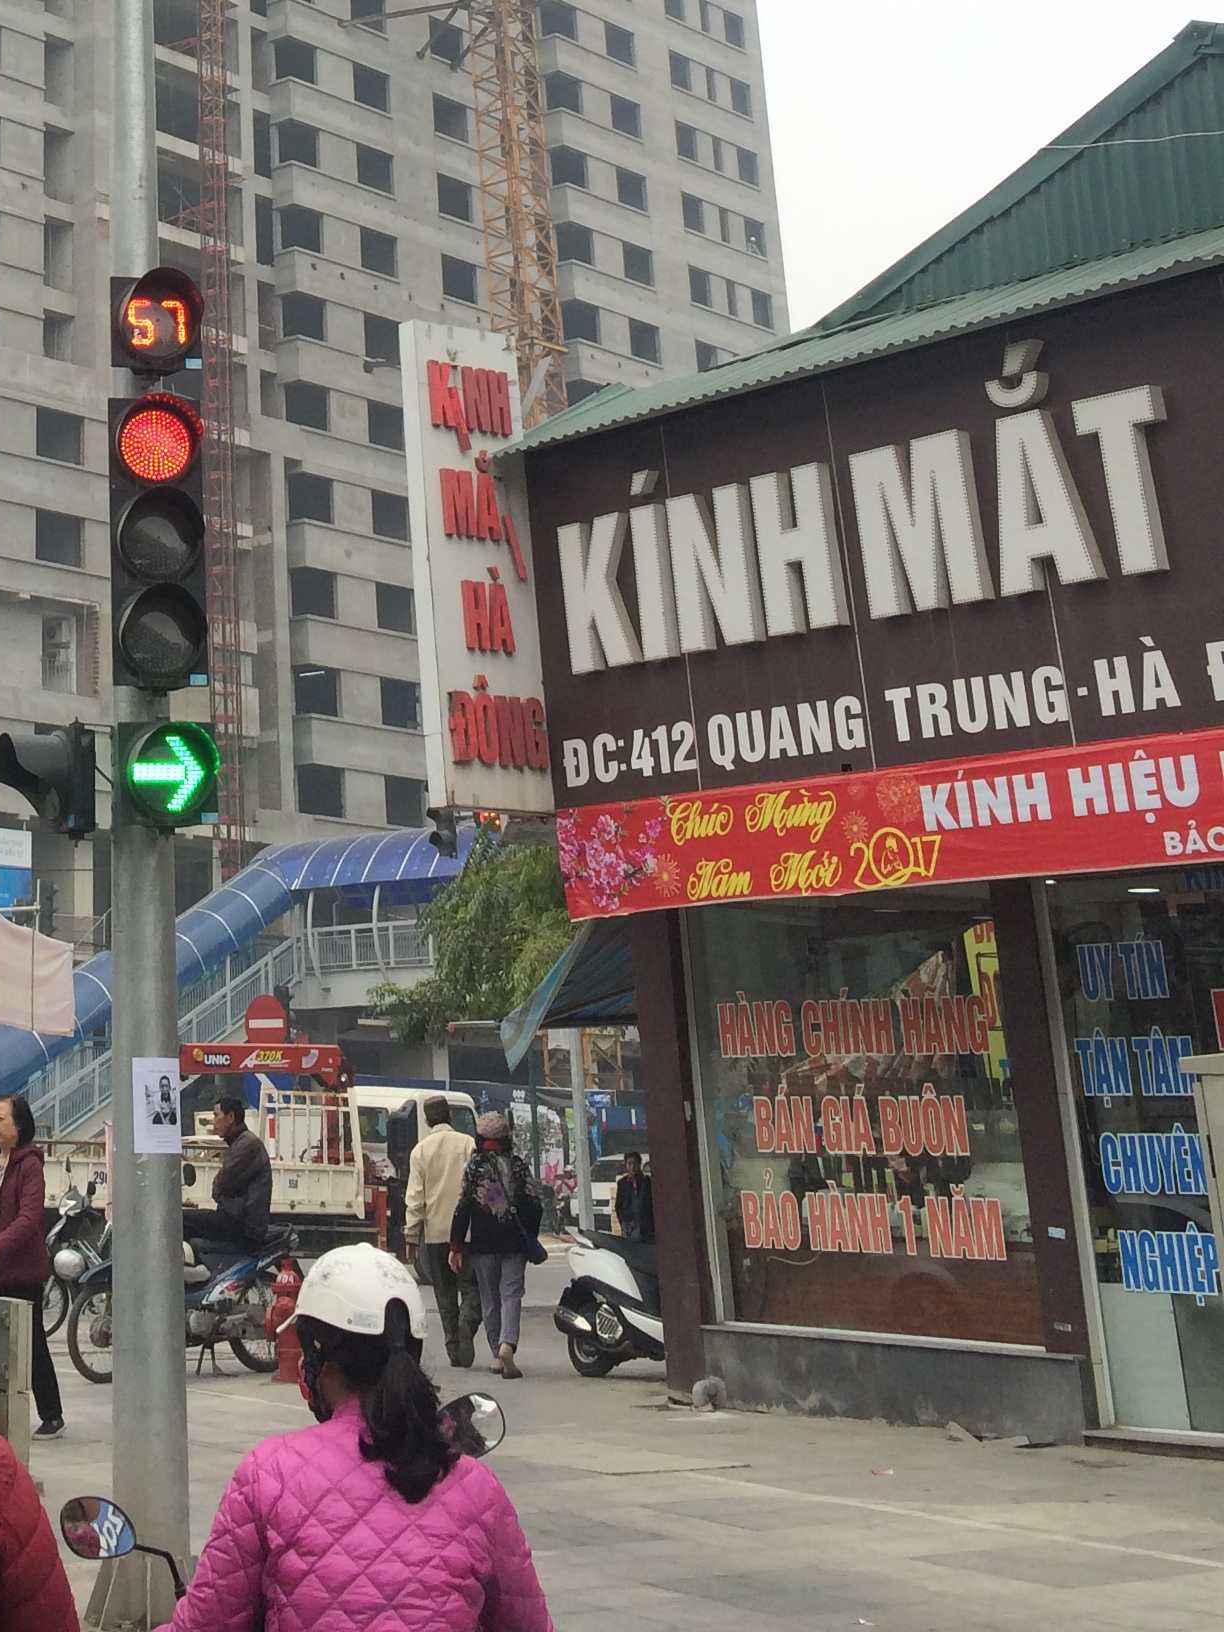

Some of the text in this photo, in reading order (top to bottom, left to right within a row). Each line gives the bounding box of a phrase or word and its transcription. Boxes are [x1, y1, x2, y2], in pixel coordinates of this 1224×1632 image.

[127, 299, 186, 346] 57
[556, 339, 1171, 675] KÍNH MẮT
[460, 566, 516, 655] HÀ
[448, 673, 548, 770] ĐÔNG
[707, 695, 866, 768] QUANG
[667, 789, 837, 846] Chúc Mừng
[919, 770, 1052, 833] KÍNH
[1067, 749, 1200, 825] HIỆU
[770, 849, 842, 896] Mới
[1076, 943, 1114, 1002] UY
[1117, 932, 1170, 1000] TÍN
[717, 991, 796, 1058] HÀNG
[801, 986, 896, 1057] CHÍNH
[897, 984, 991, 1055] HÃNG
[204, 1053, 231, 1066] UNIC
[753, 1082, 971, 1157] BÁN GIÁ BUÔN
[94, 1171, 108, 1184] 29
[1098, 1122, 1209, 1196] CHUYÊN
[741, 1167, 1007, 1261] BẢO HÀNH 1 NĂM
[1117, 1221, 1221, 1307] NGHIỆP
